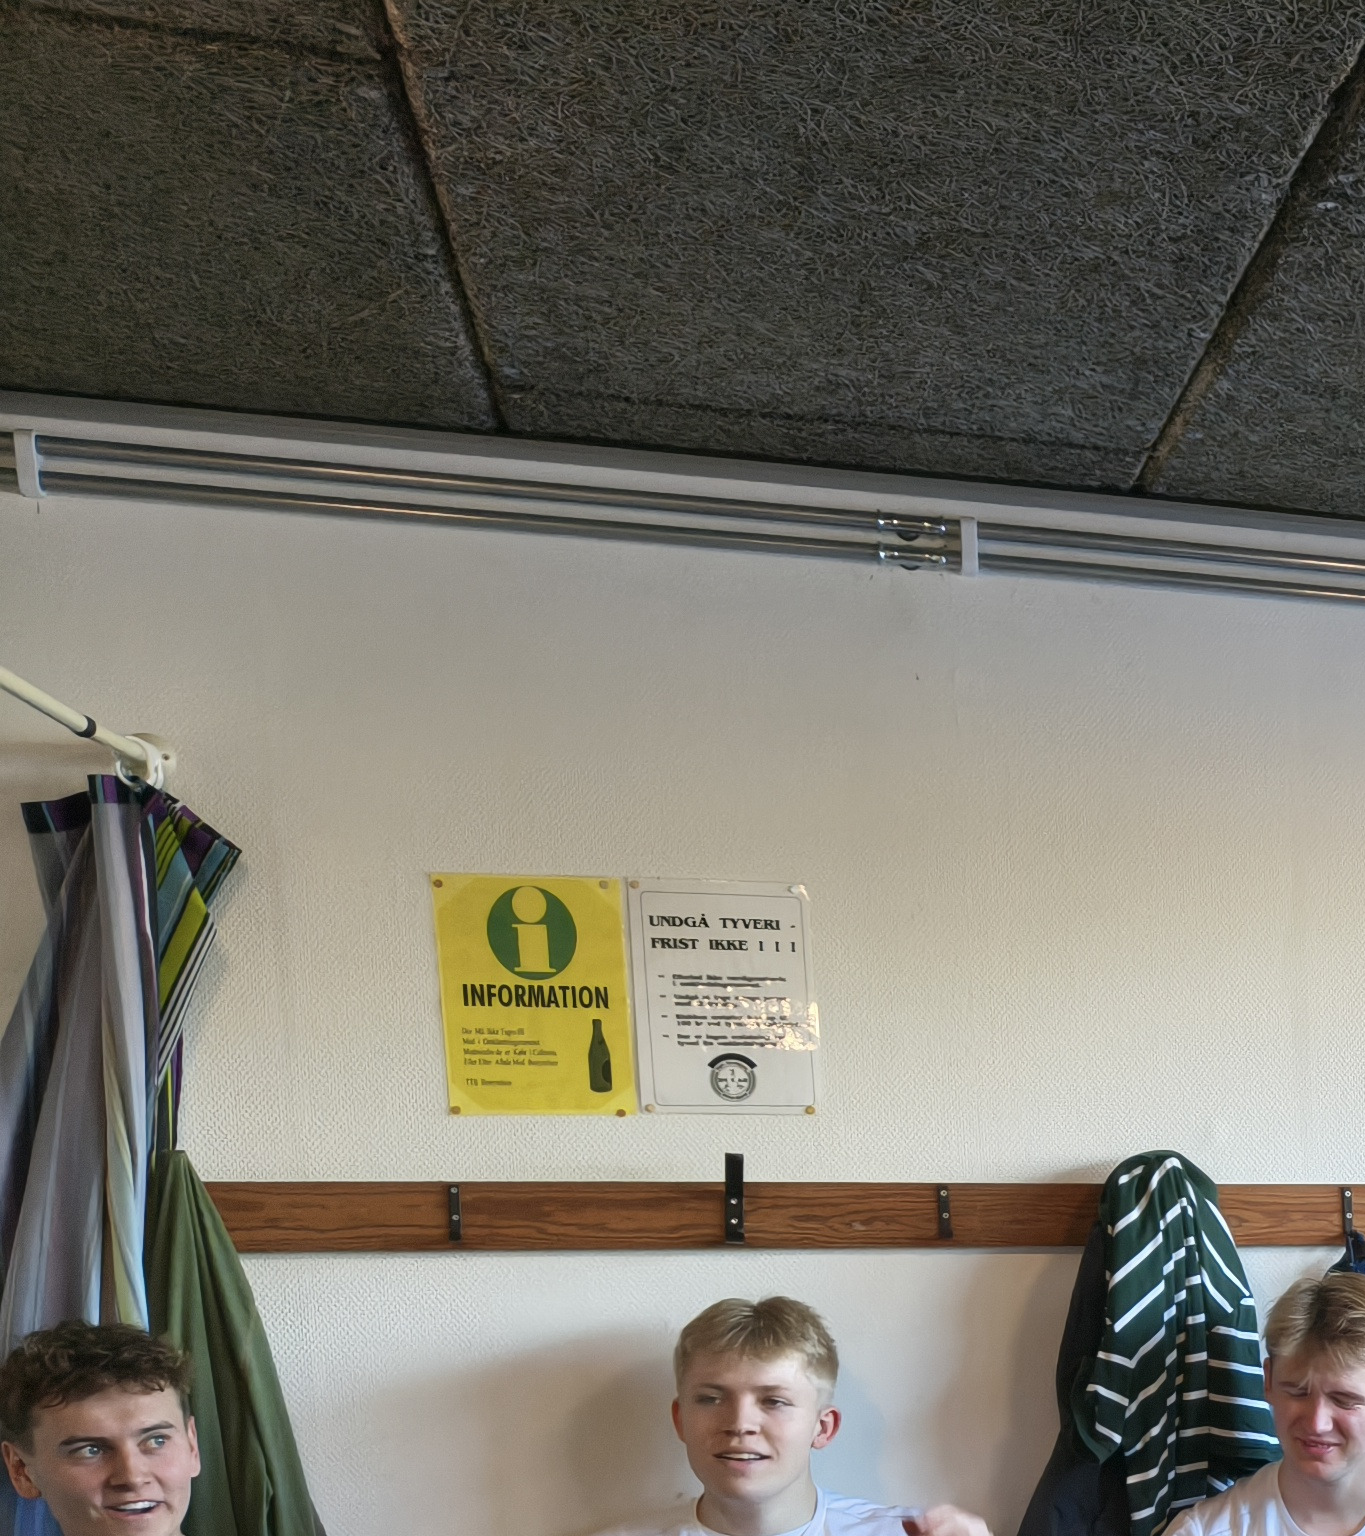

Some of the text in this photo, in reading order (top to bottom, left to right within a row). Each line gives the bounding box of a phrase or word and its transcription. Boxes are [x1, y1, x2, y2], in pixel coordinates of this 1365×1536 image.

[649, 914, 709, 928] UNDGÅ
[719, 918, 780, 930] TYVERI
[651, 938, 699, 950] FRIST
[709, 939, 748, 951] IKKE
[462, 984, 609, 1009] INFORMATION
